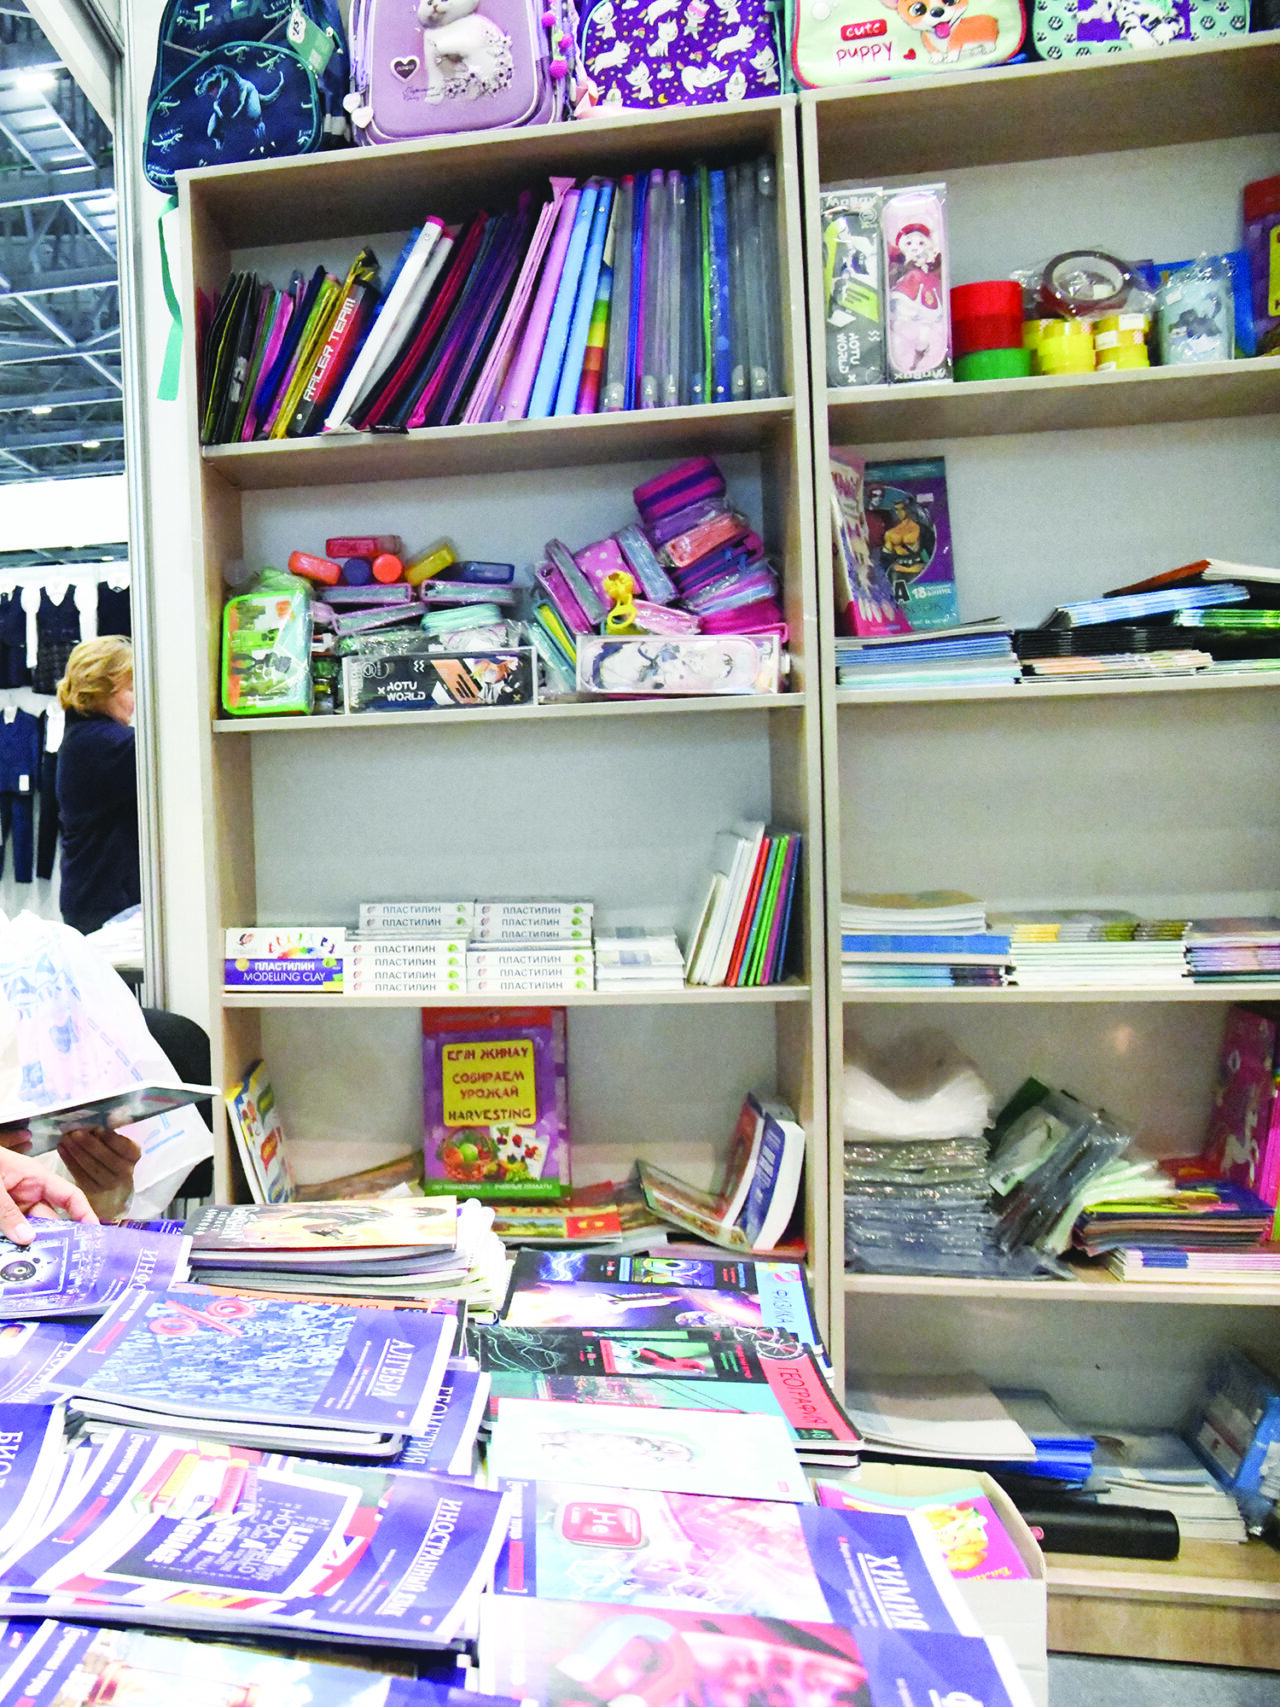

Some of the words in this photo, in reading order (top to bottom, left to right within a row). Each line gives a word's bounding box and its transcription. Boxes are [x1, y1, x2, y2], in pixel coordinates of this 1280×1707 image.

[845, 22, 883, 38] cute
[836, 42, 893, 61] puppy
[303, 344, 334, 402] RACER
[328, 297, 356, 342] TEAM
[386, 691, 426, 702] WORLD
[383, 906, 442, 914] ПЛАСТИЛИН
[503, 906, 561, 914] ПЛАСТИЛИН
[383, 918, 442, 927] ПЛАСТИЛИН
[502, 918, 560, 926] ПЛАСТИЛИН
[502, 930, 560, 938] ПЛАСТИЛИН
[374, 945, 436, 953] ПЛАСТИЛИН
[375, 958, 436, 966] ПЛАСТИЛИН
[499, 956, 561, 964] ПЛАСТИЛИН
[255, 962, 315, 971] ПЛАСТИЛИН
[243, 972, 300, 982] MODELLING
[302, 972, 326, 982] CLAY
[375, 971, 436, 979] ПЛАСТИЛИН
[500, 968, 563, 977] ПЛАСТИЛИН
[375, 983, 436, 992] ПЛАСТИЛИН
[500, 981, 563, 990] ПЛАСТИЛИН
[452, 1070, 525, 1084] СОБИРАЕМ
[460, 1087, 519, 1100] УРОЖАЙ
[448, 1108, 532, 1121] HARVESTING
[371, 1338, 415, 1398] АЛГЕБРА
[777, 1367, 828, 1425] ГЕОГРАФИЯ
[403, 1386, 454, 1466] ГЕОМЕТРИЯ
[400, 1499, 463, 1592] ИНОСТРАННЫЙ
[866, 1553, 930, 1631] ХИМИЯ
